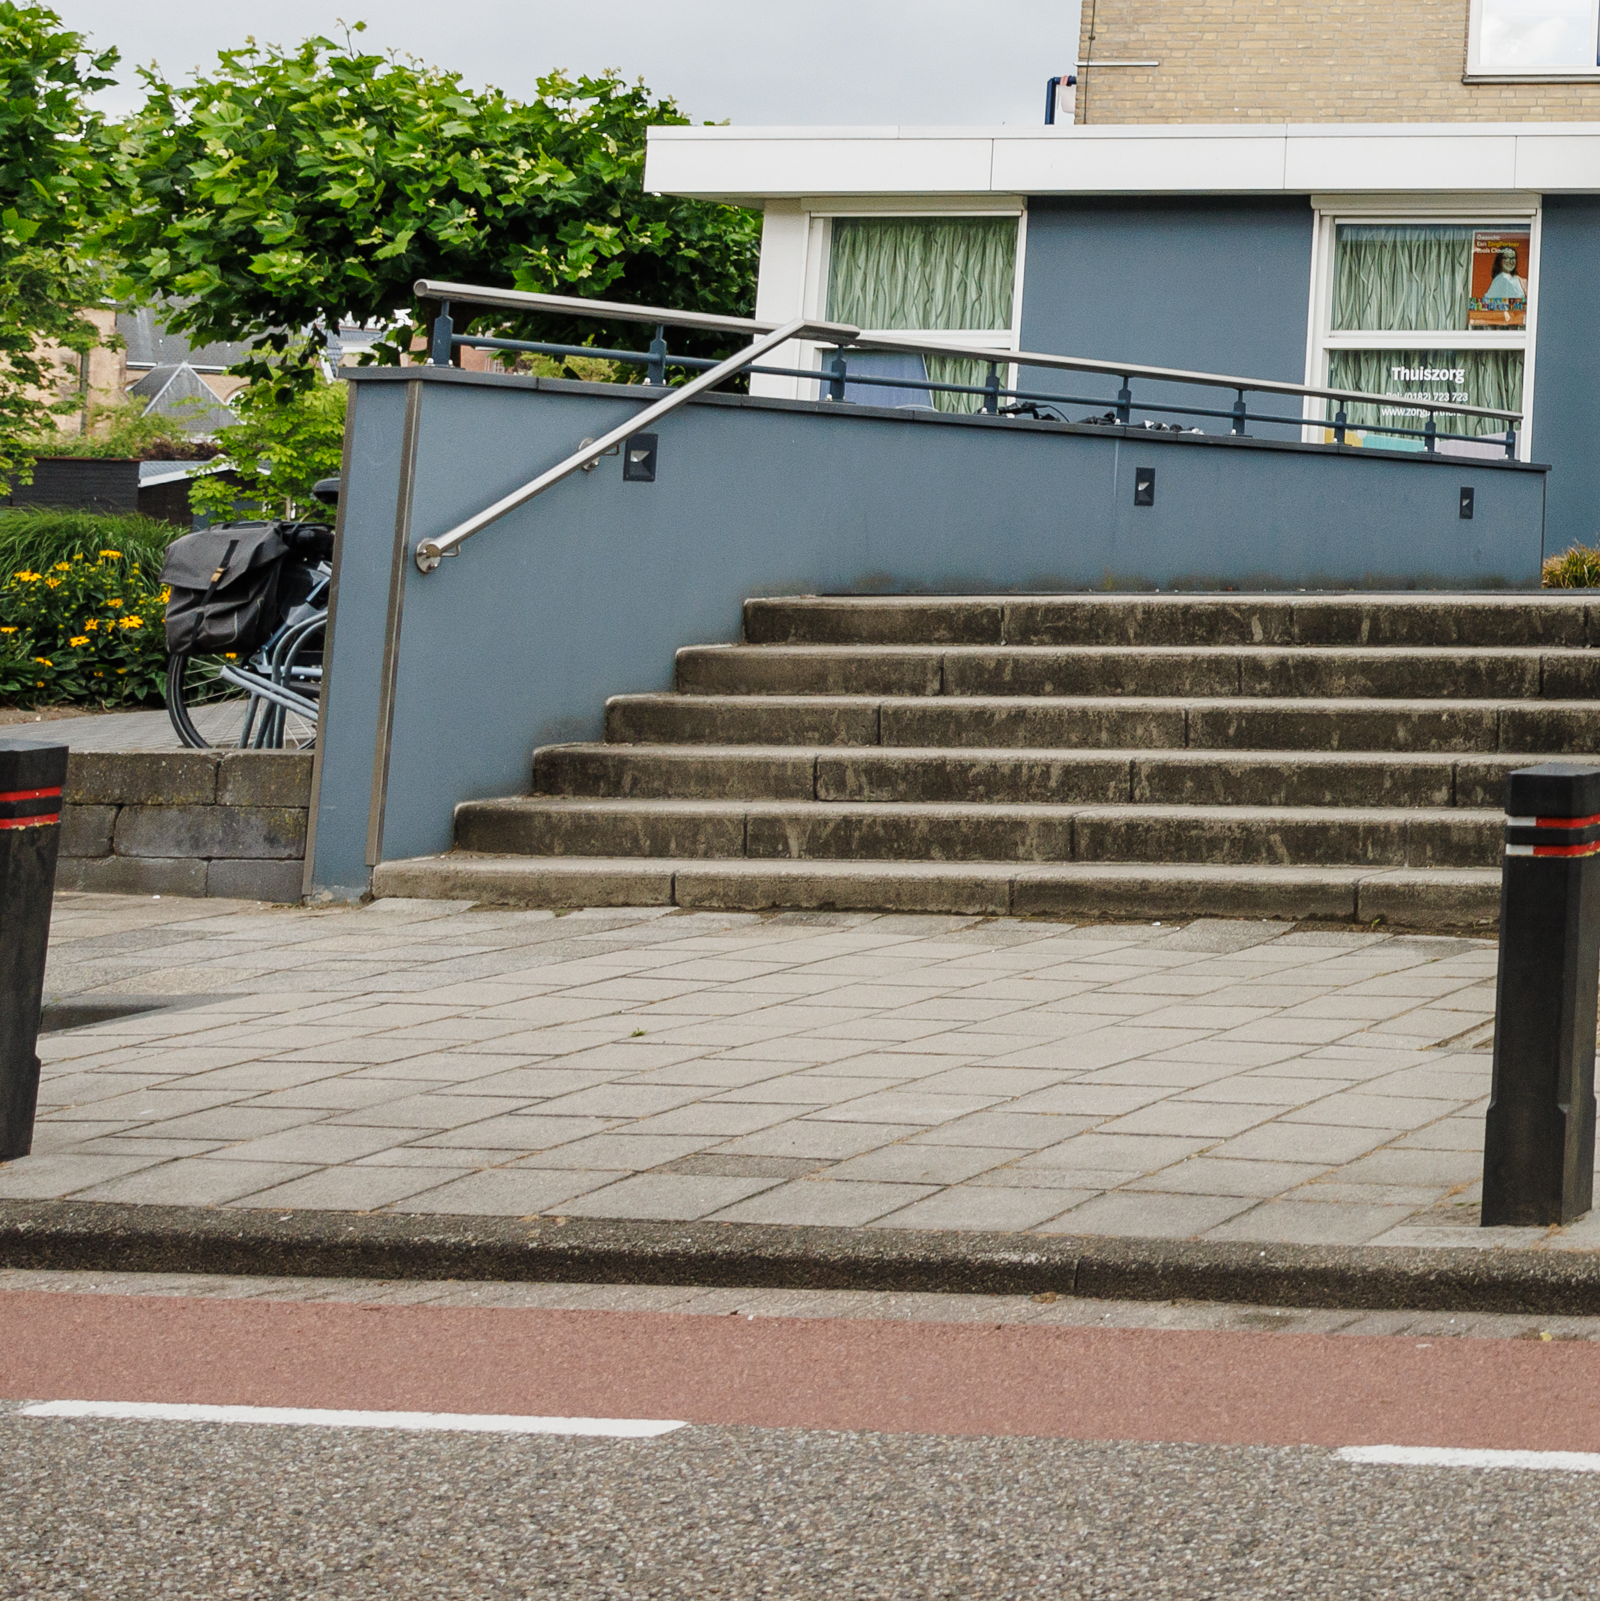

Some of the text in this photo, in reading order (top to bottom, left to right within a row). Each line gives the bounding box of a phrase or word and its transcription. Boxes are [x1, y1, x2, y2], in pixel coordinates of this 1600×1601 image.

[1391, 366, 1465, 384] Thuiszorg
[1433, 392, 1450, 402] 723
[1452, 392, 1468, 402] 723
